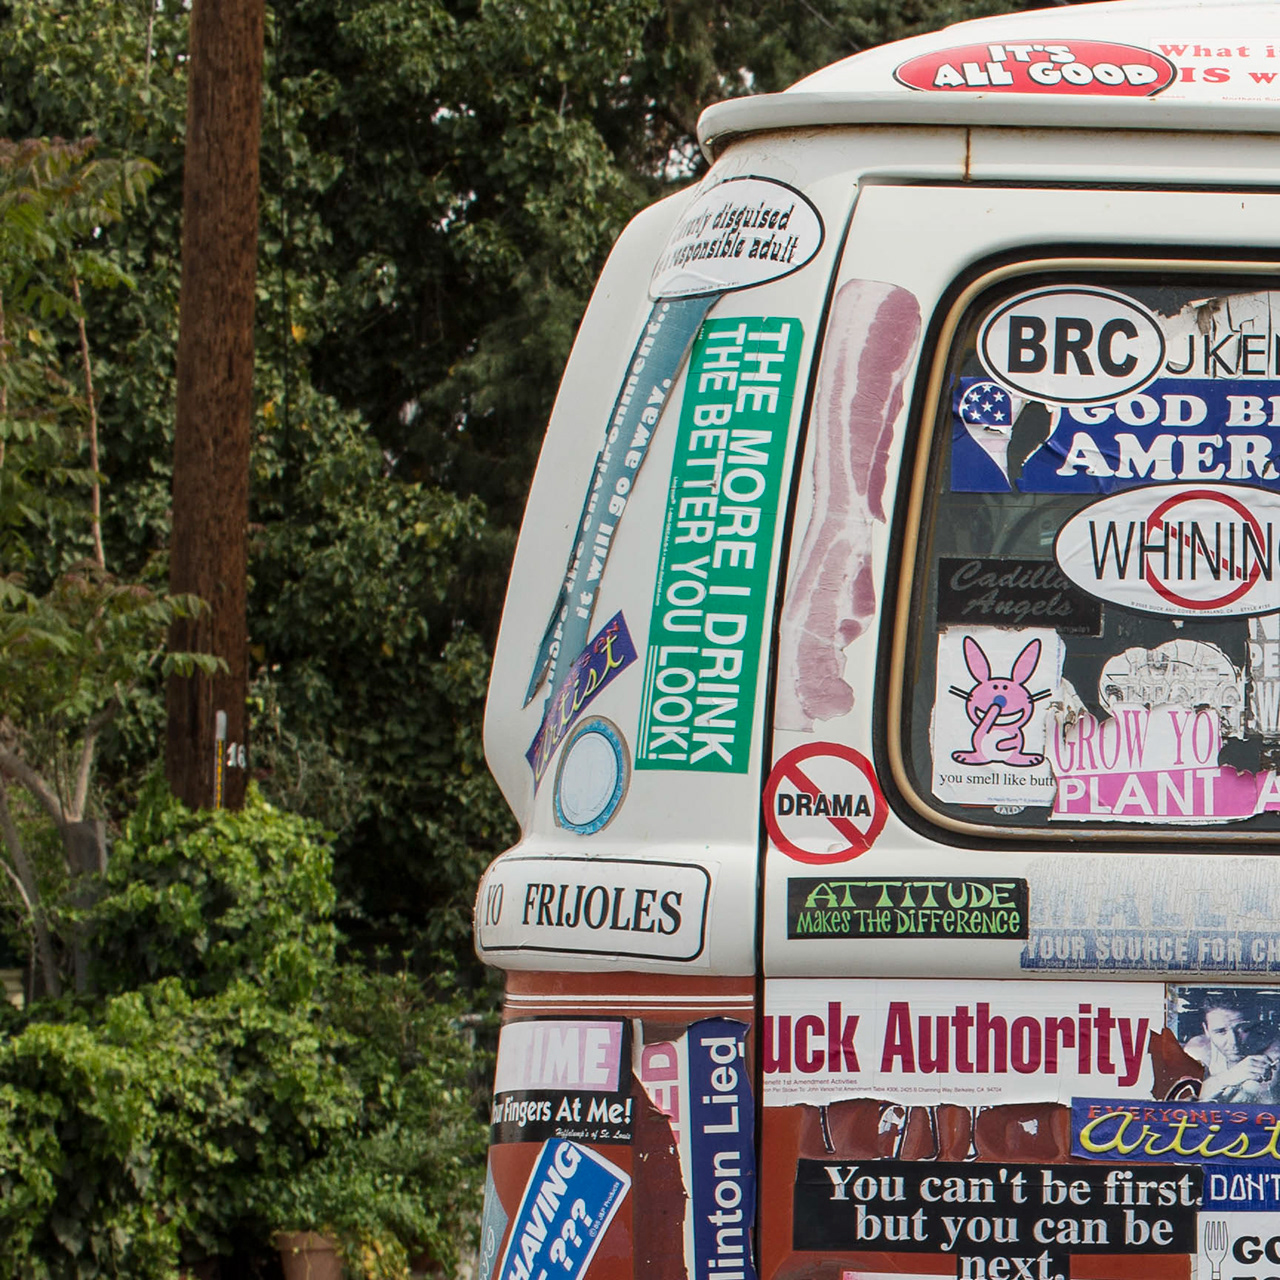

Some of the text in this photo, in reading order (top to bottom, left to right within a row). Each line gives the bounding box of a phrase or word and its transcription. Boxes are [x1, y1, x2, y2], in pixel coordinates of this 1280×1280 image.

[933, 63, 1159, 87] ALL GOOD
[989, 45, 1076, 64] IT'S
[1160, 44, 1249, 60] What
[1179, 67, 1231, 82] IS
[701, 323, 747, 392] THE
[1007, 316, 1141, 376] BRC
[1070, 394, 1208, 426] GOD
[675, 403, 730, 545] BETTER
[690, 322, 790, 766] THE MORE I DRINK
[663, 555, 709, 632] YOU
[648, 646, 699, 761] LOOK!
[777, 792, 872, 818] DRAMA
[522, 883, 684, 936] FRIJOLES
